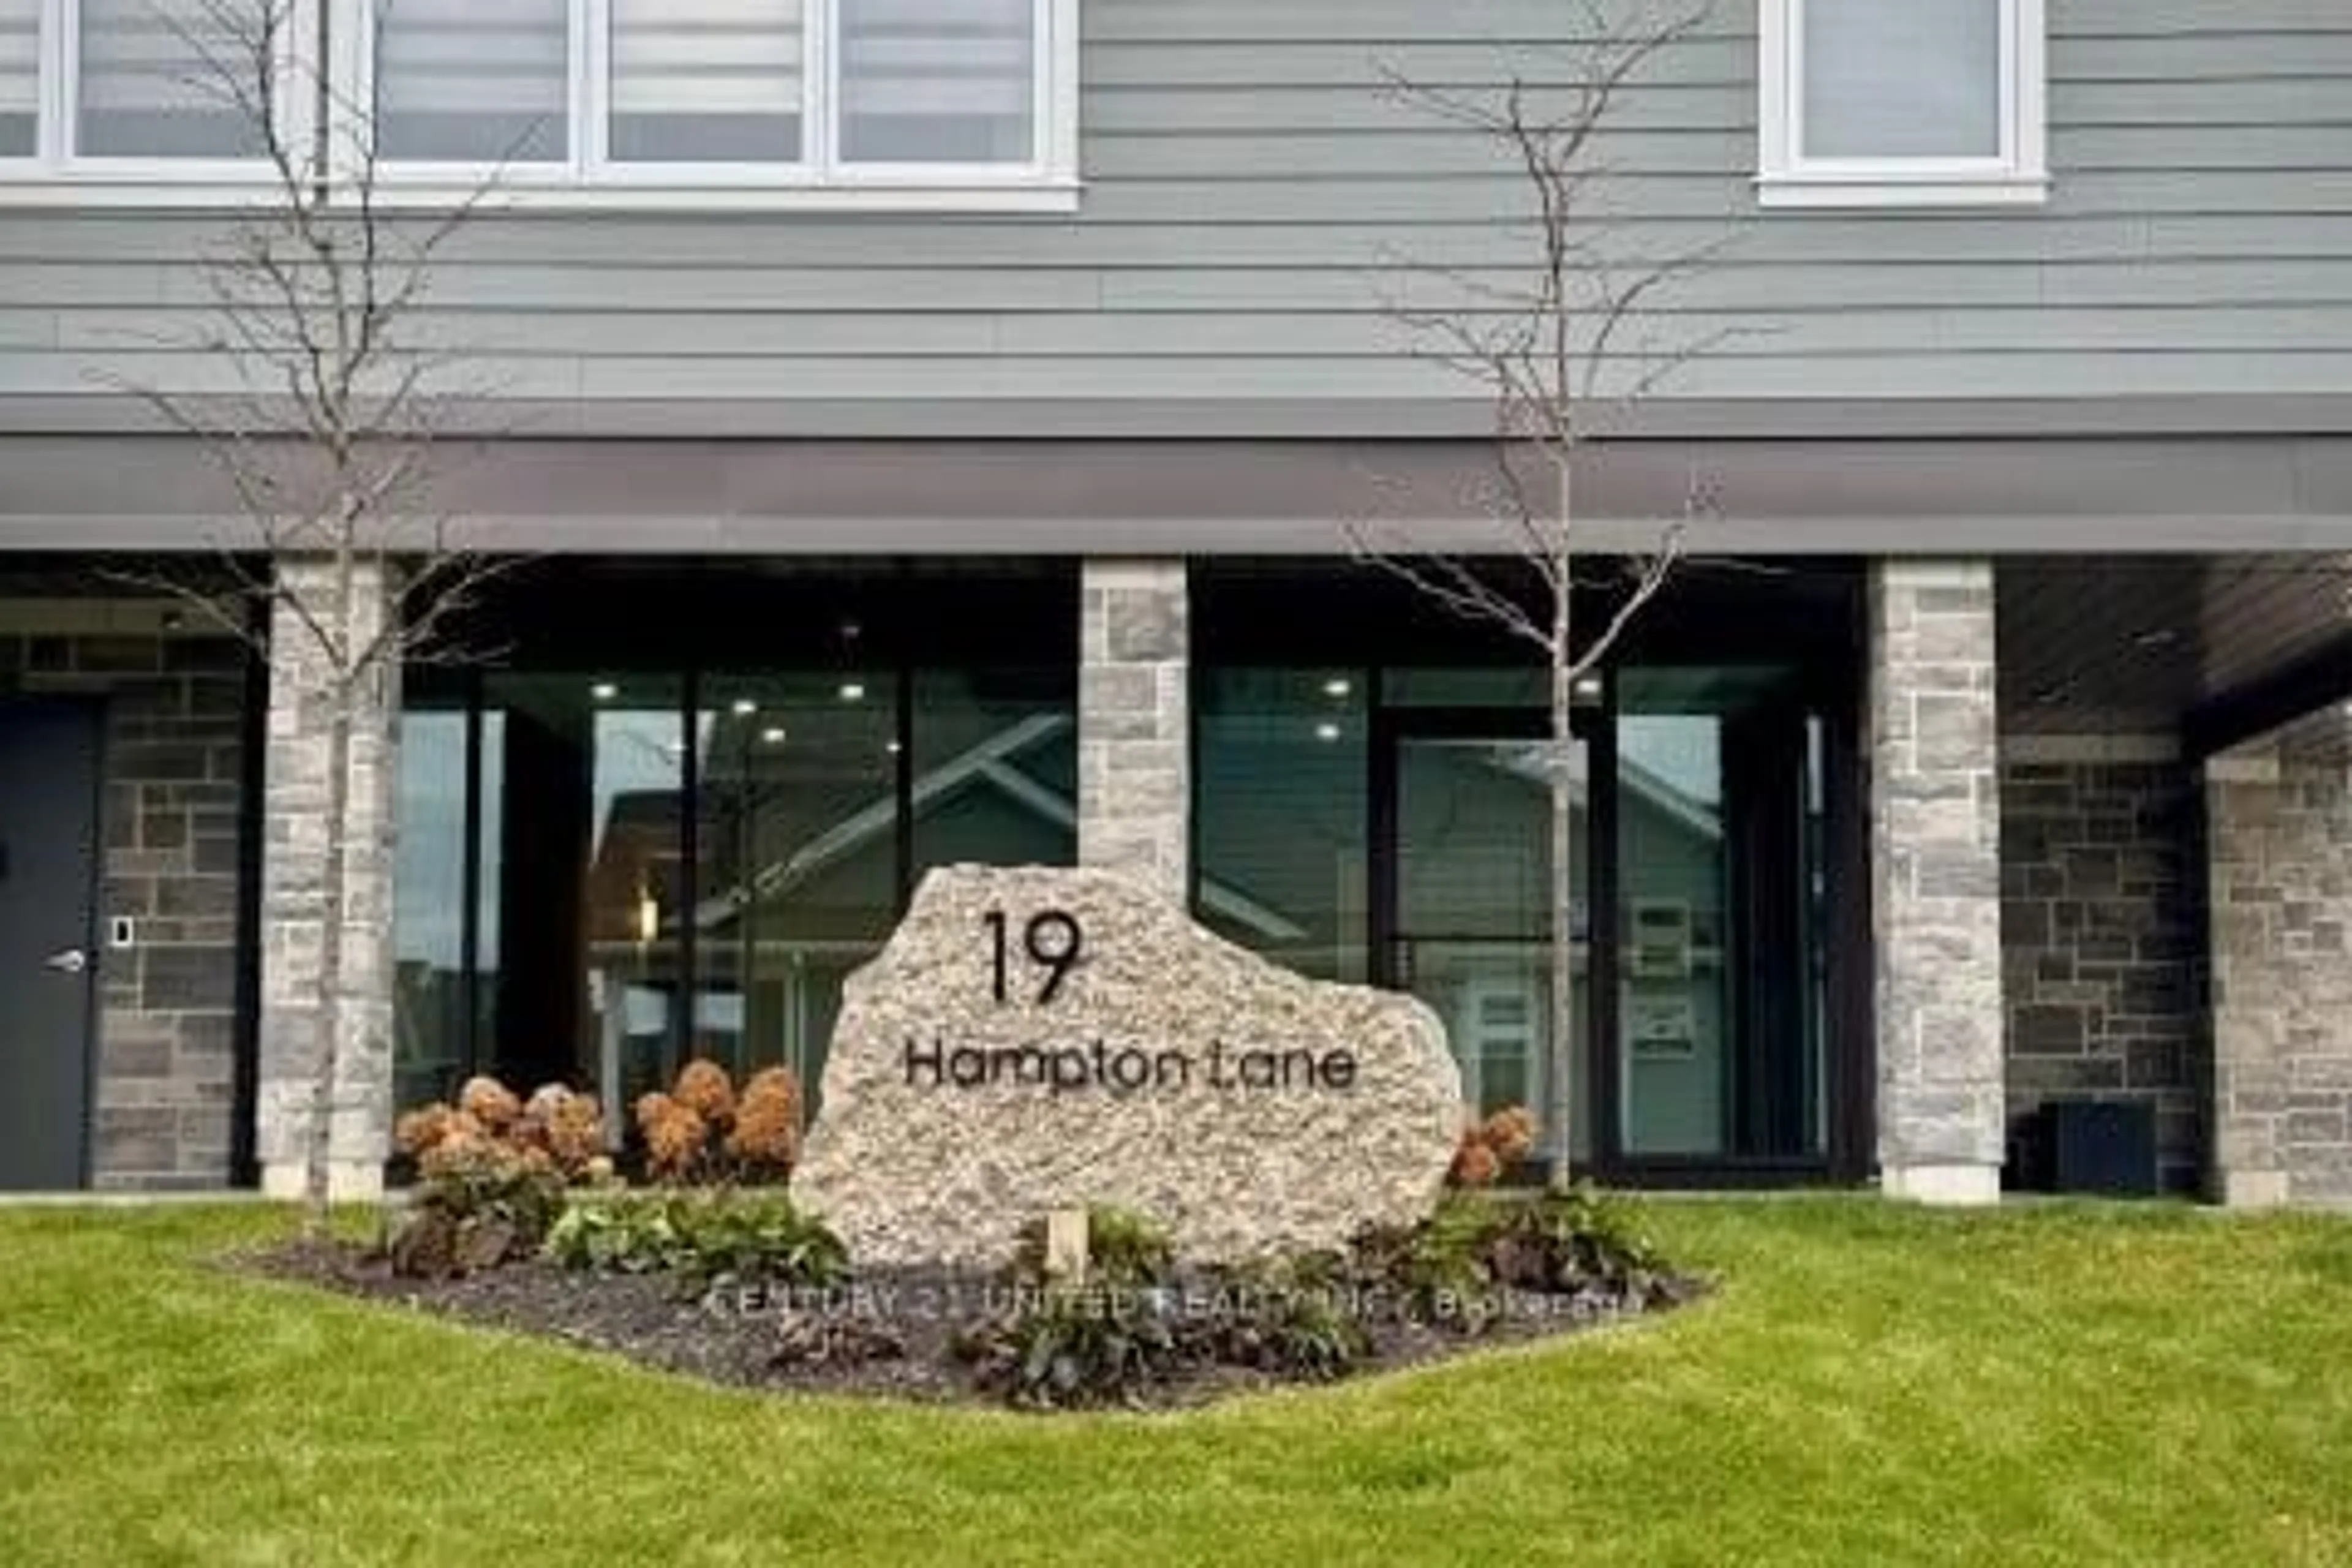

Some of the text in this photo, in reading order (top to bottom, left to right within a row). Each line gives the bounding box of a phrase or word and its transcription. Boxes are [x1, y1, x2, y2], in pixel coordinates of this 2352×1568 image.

[984, 908, 1084, 1005] 19
[904, 1039, 1357, 1096] Hampton Lane
